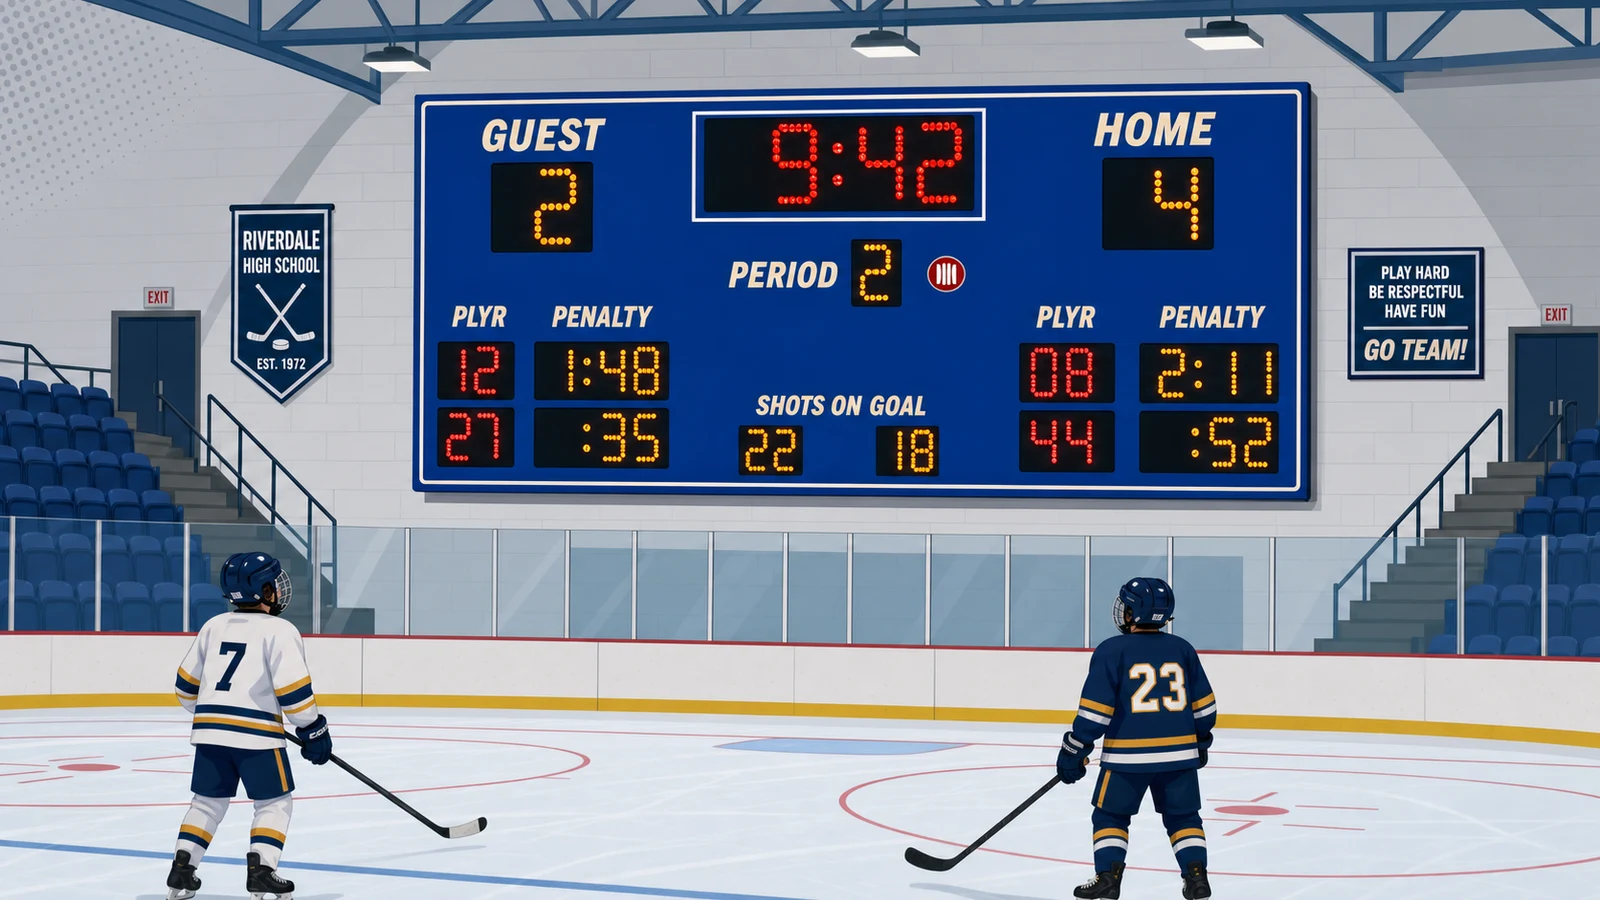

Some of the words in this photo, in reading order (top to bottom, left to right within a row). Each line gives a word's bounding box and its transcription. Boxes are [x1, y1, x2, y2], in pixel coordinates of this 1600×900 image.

[482, 118, 606, 152] GUEST
[1094, 112, 1216, 146] HOME
[772, 122, 962, 204] 9:42
[534, 168, 577, 245] 2
[1154, 168, 1199, 240] 4
[244, 230, 320, 250] RIVERDALE
[244, 258, 270, 273] HIGH
[275, 257, 319, 273] SCHOOL
[729, 261, 837, 288] PERIOD
[860, 244, 891, 301] 2
[1382, 266, 1411, 279] PLAY
[1416, 266, 1449, 279] HARD
[148, 291, 168, 304] EXIT
[1370, 285, 1384, 298] BE
[1389, 285, 1463, 298] RESPECTFUL
[452, 306, 506, 327] PLYR
[552, 306, 653, 327] PENALTY
[1037, 306, 1095, 328] PLYR
[1160, 306, 1265, 328] PENALTY
[1385, 304, 1416, 318] HAVE
[1422, 304, 1445, 317] FUN
[1546, 308, 1567, 321] EXIT
[256, 358, 278, 370] EST.
[282, 358, 306, 370] 1972
[1365, 339, 1395, 360] GO
[1402, 339, 1468, 360] TEAM!
[461, 346, 499, 394] 12
[568, 346, 659, 395] 1:48
[1030, 347, 1093, 398] 08
[1158, 348, 1272, 398] 2:11
[756, 395, 825, 415] SHOTS
[832, 395, 862, 415] ON
[870, 395, 925, 416] GOAL
[446, 413, 499, 461] 27
[583, 413, 659, 462] :35
[745, 429, 796, 471] 22
[897, 429, 934, 472] 18
[1030, 420, 1092, 464] 44
[1191, 417, 1272, 467] :52
[215, 642, 247, 691] 7
[1128, 662, 1187, 713] 23
